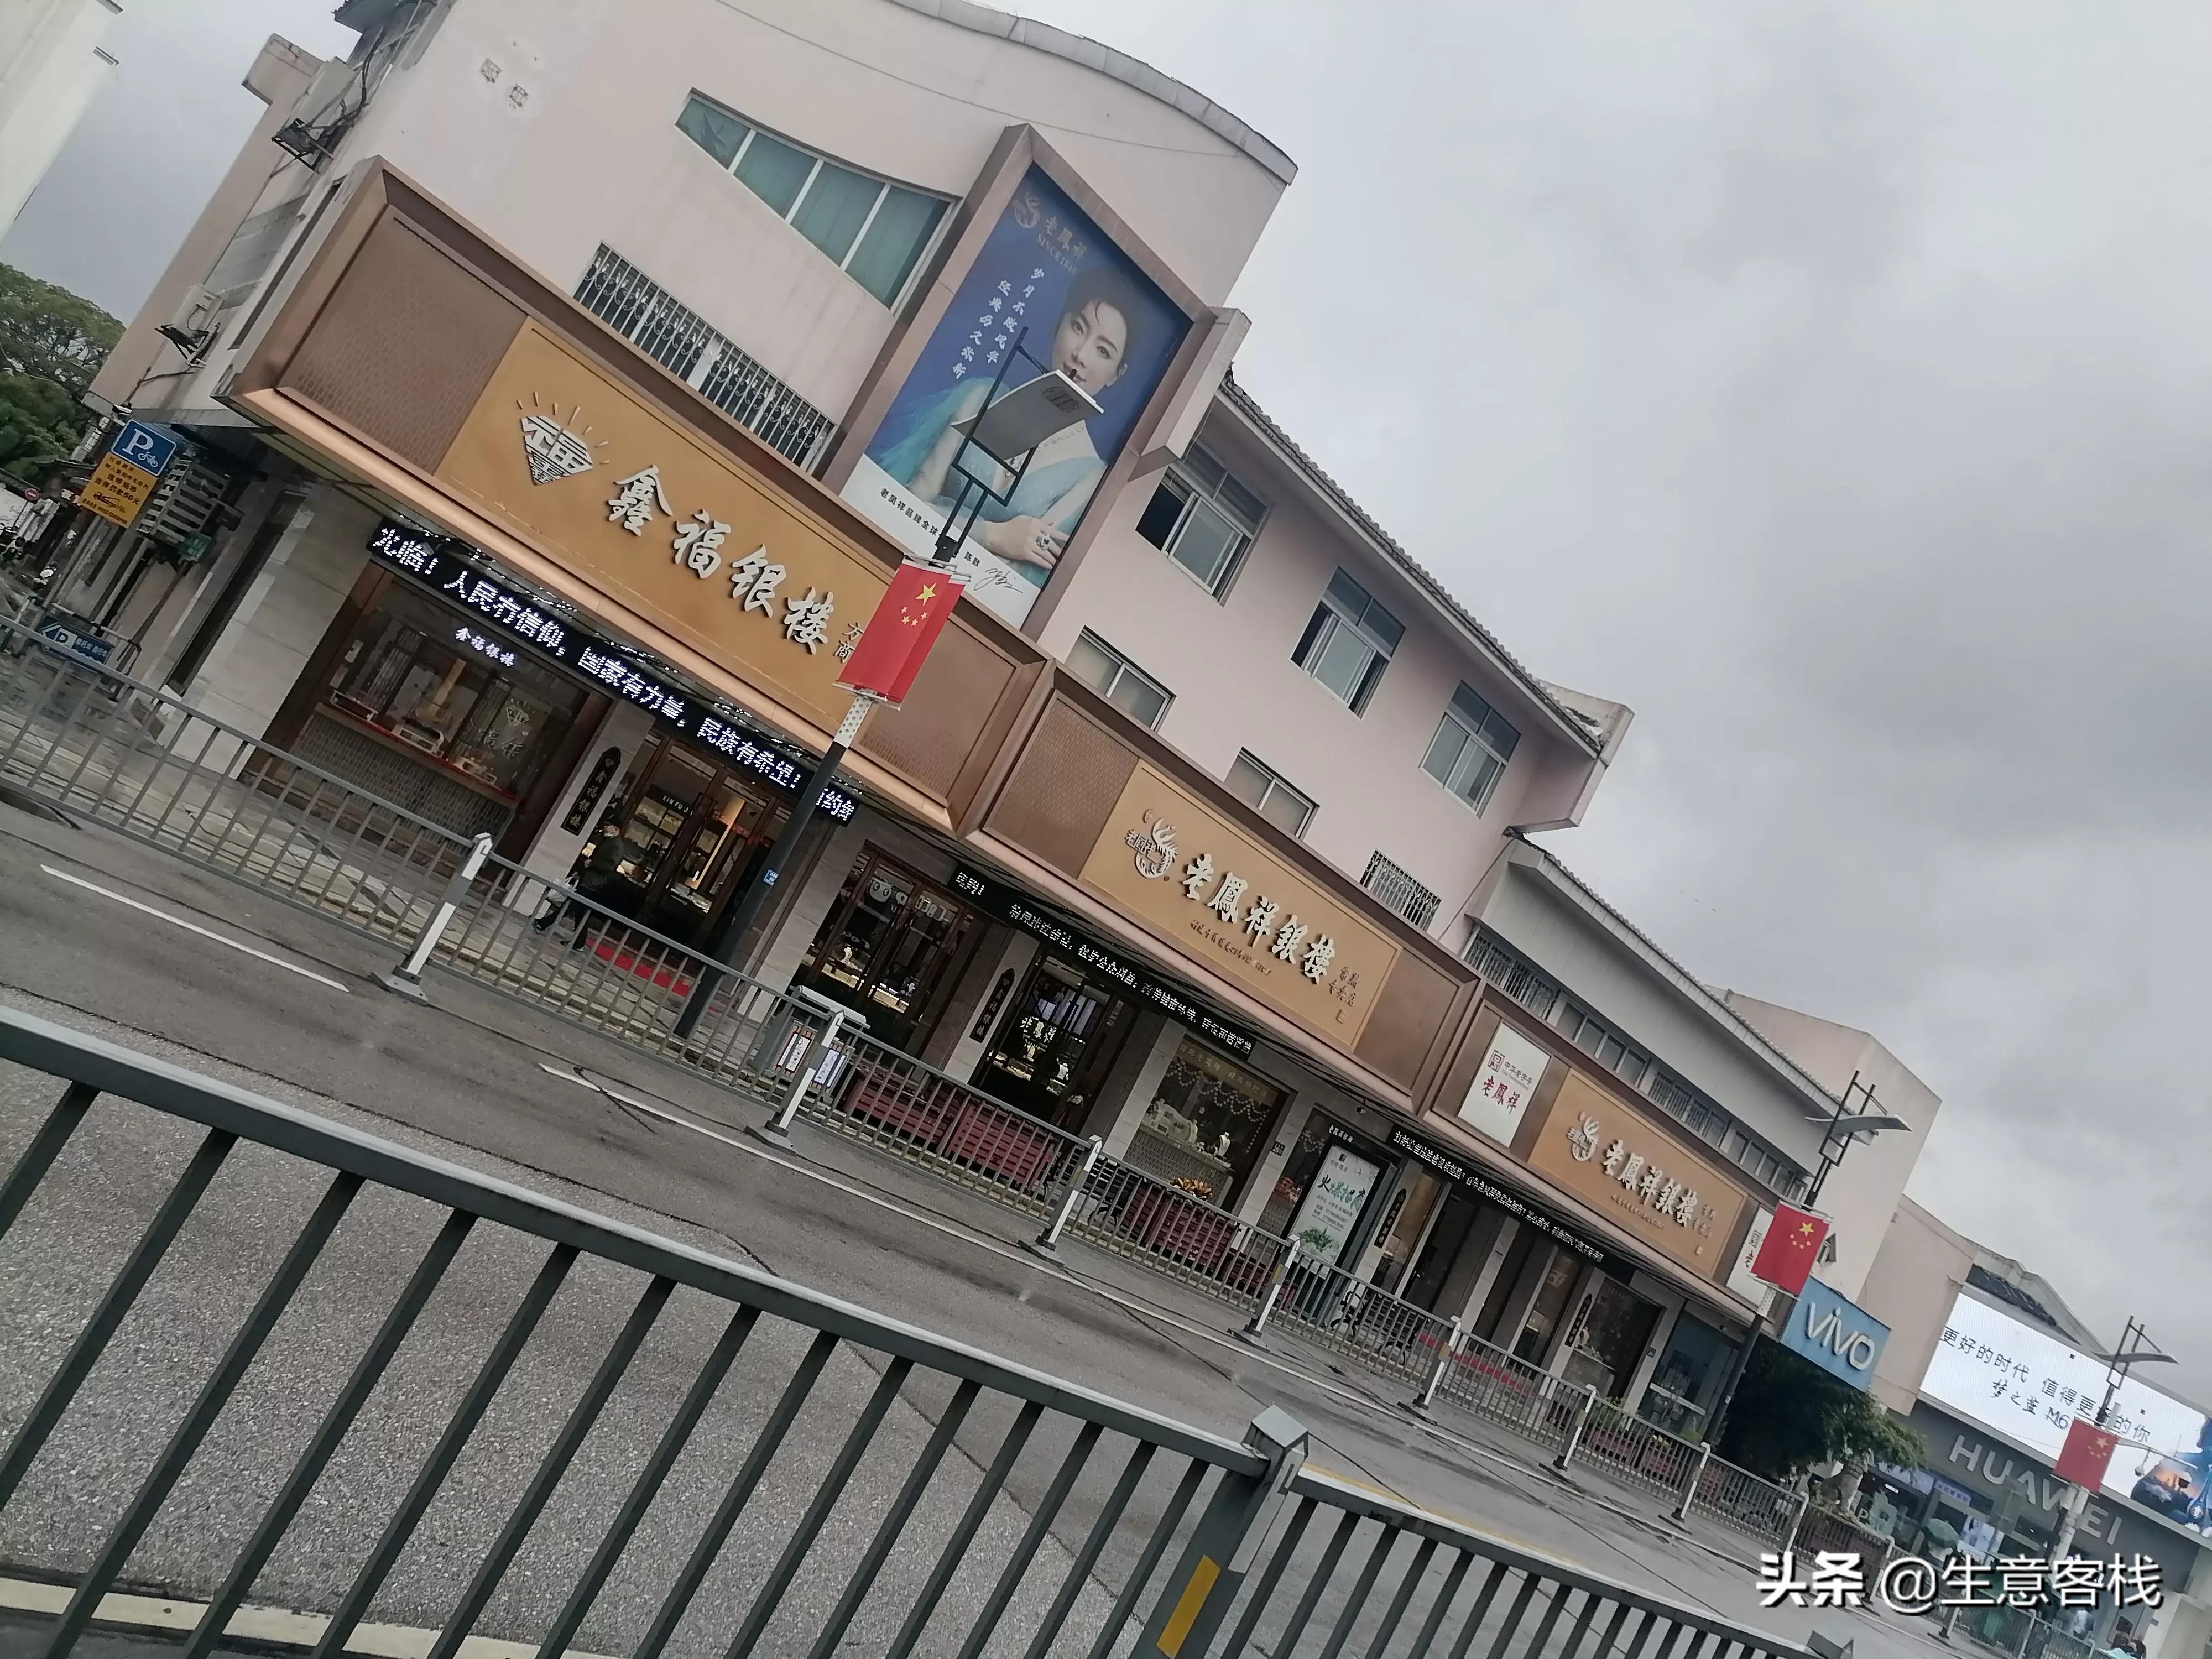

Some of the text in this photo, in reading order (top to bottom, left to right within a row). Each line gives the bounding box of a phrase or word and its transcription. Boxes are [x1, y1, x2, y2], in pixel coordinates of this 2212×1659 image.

[121, 428, 154, 456] P
[608, 465, 834, 655] 鑫福银楼
[1939, 1326, 2031, 1383] 更好的时代
